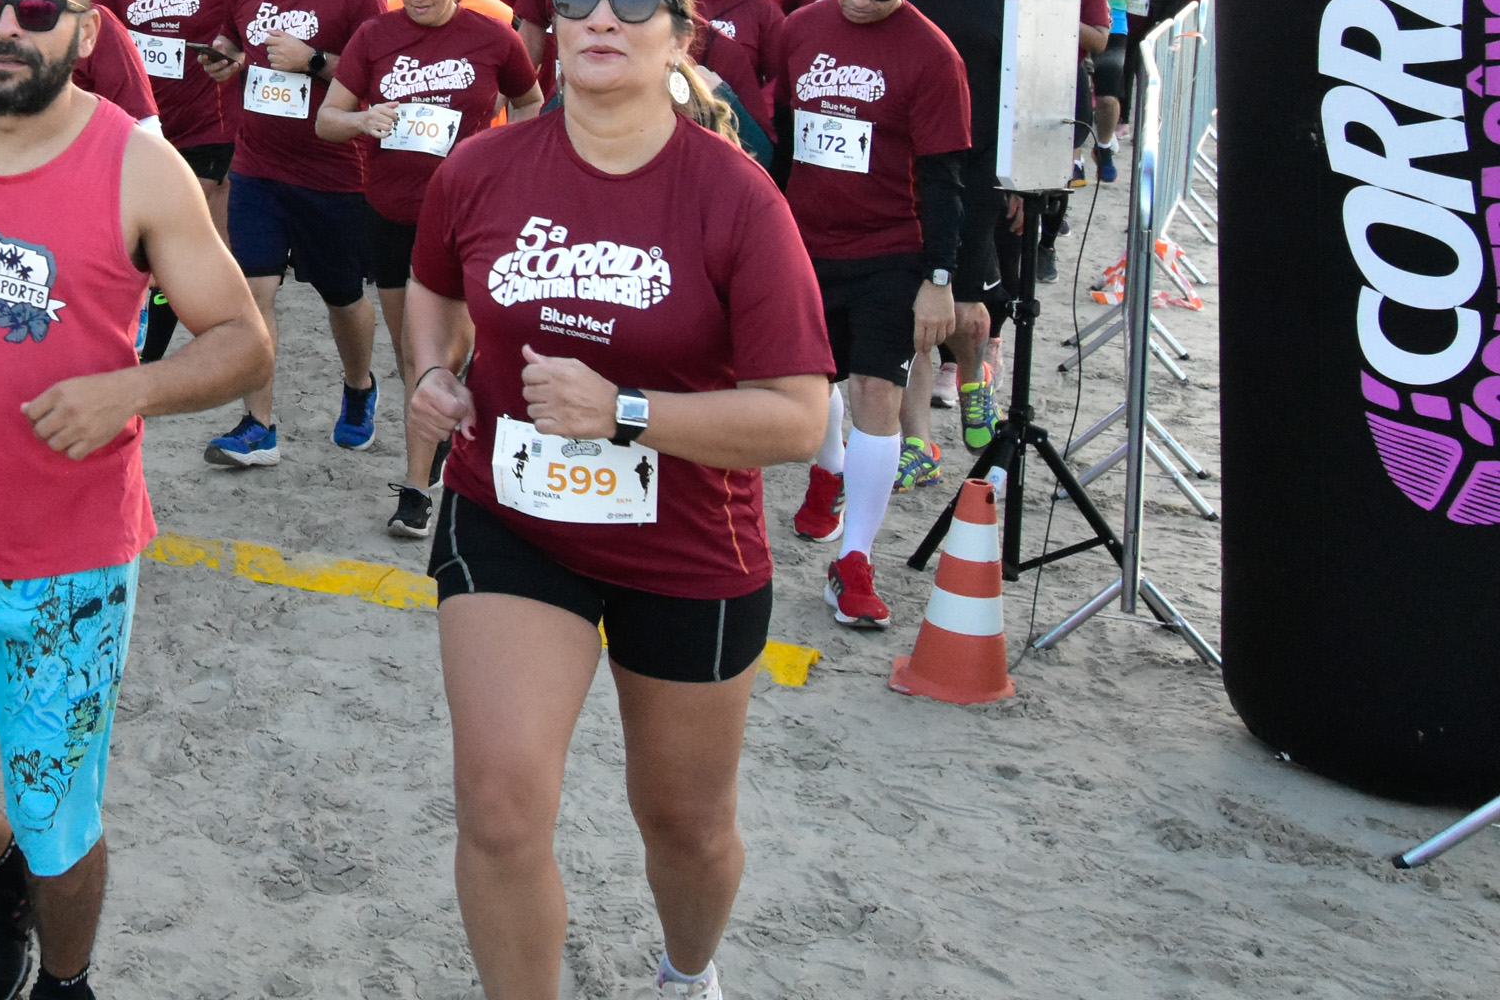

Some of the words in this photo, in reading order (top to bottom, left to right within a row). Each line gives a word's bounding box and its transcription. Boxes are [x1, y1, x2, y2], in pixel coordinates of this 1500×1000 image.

[260, 10, 319, 32] CORRIDA
[142, 49, 167, 65] 190
[395, 59, 476, 85] CORRIDA
[811, 65, 886, 91] CORRIDA
[261, 85, 291, 103] 696
[821, 100, 838, 111] Blue
[839, 103, 857, 114] Med
[407, 120, 440, 138] 700
[817, 133, 847, 154] 172
[519, 240, 672, 286] CORRIDA
[506, 275, 576, 307] CONTRA
[540, 306, 577, 326] Blue
[577, 313, 616, 336] Med
[565, 328, 611, 345] CONSCIENTE
[547, 462, 617, 496] 599
[532, 489, 562, 501] RENATA
